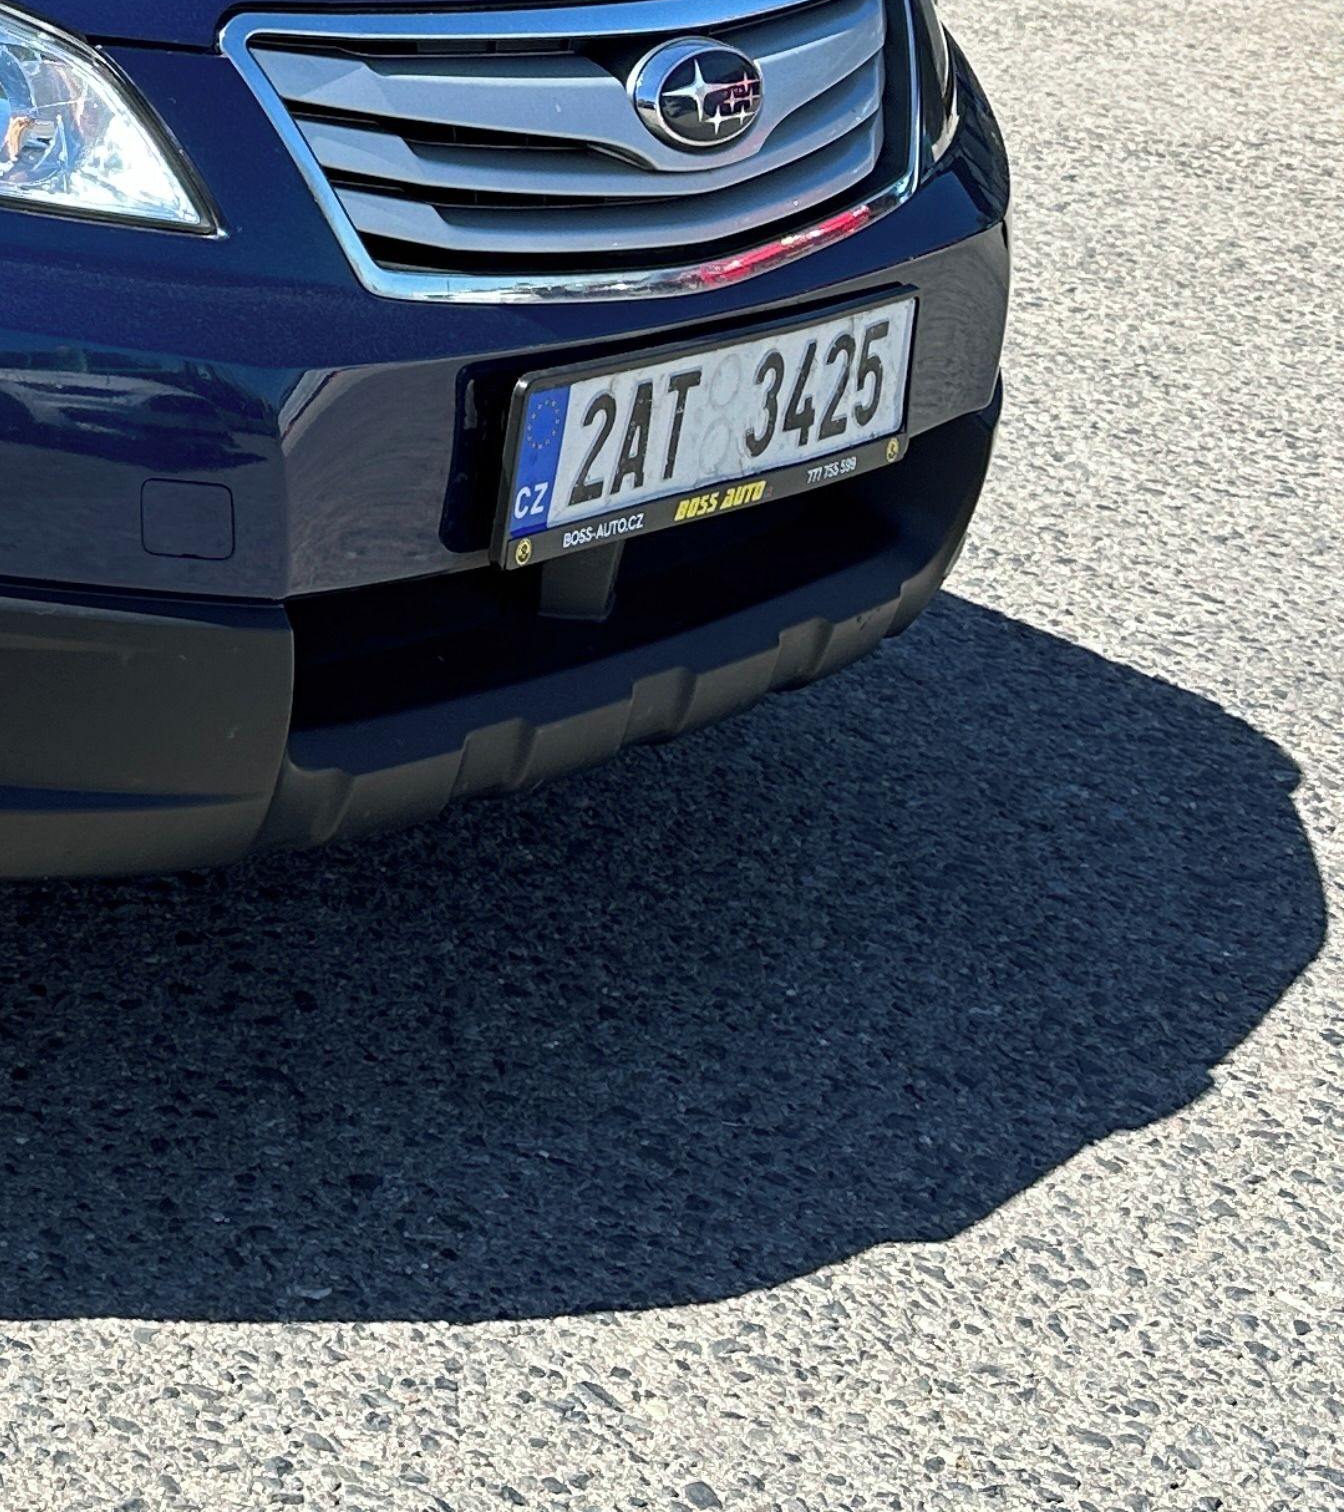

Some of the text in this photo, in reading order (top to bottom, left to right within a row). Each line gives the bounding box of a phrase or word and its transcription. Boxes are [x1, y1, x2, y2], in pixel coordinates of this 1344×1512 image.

[568, 320, 890, 506] 2AT 3425
[514, 482, 548, 519] CZ
[674, 480, 768, 522] BOSS AUTO
[562, 513, 645, 548] BOSS-AUTO.CZ
